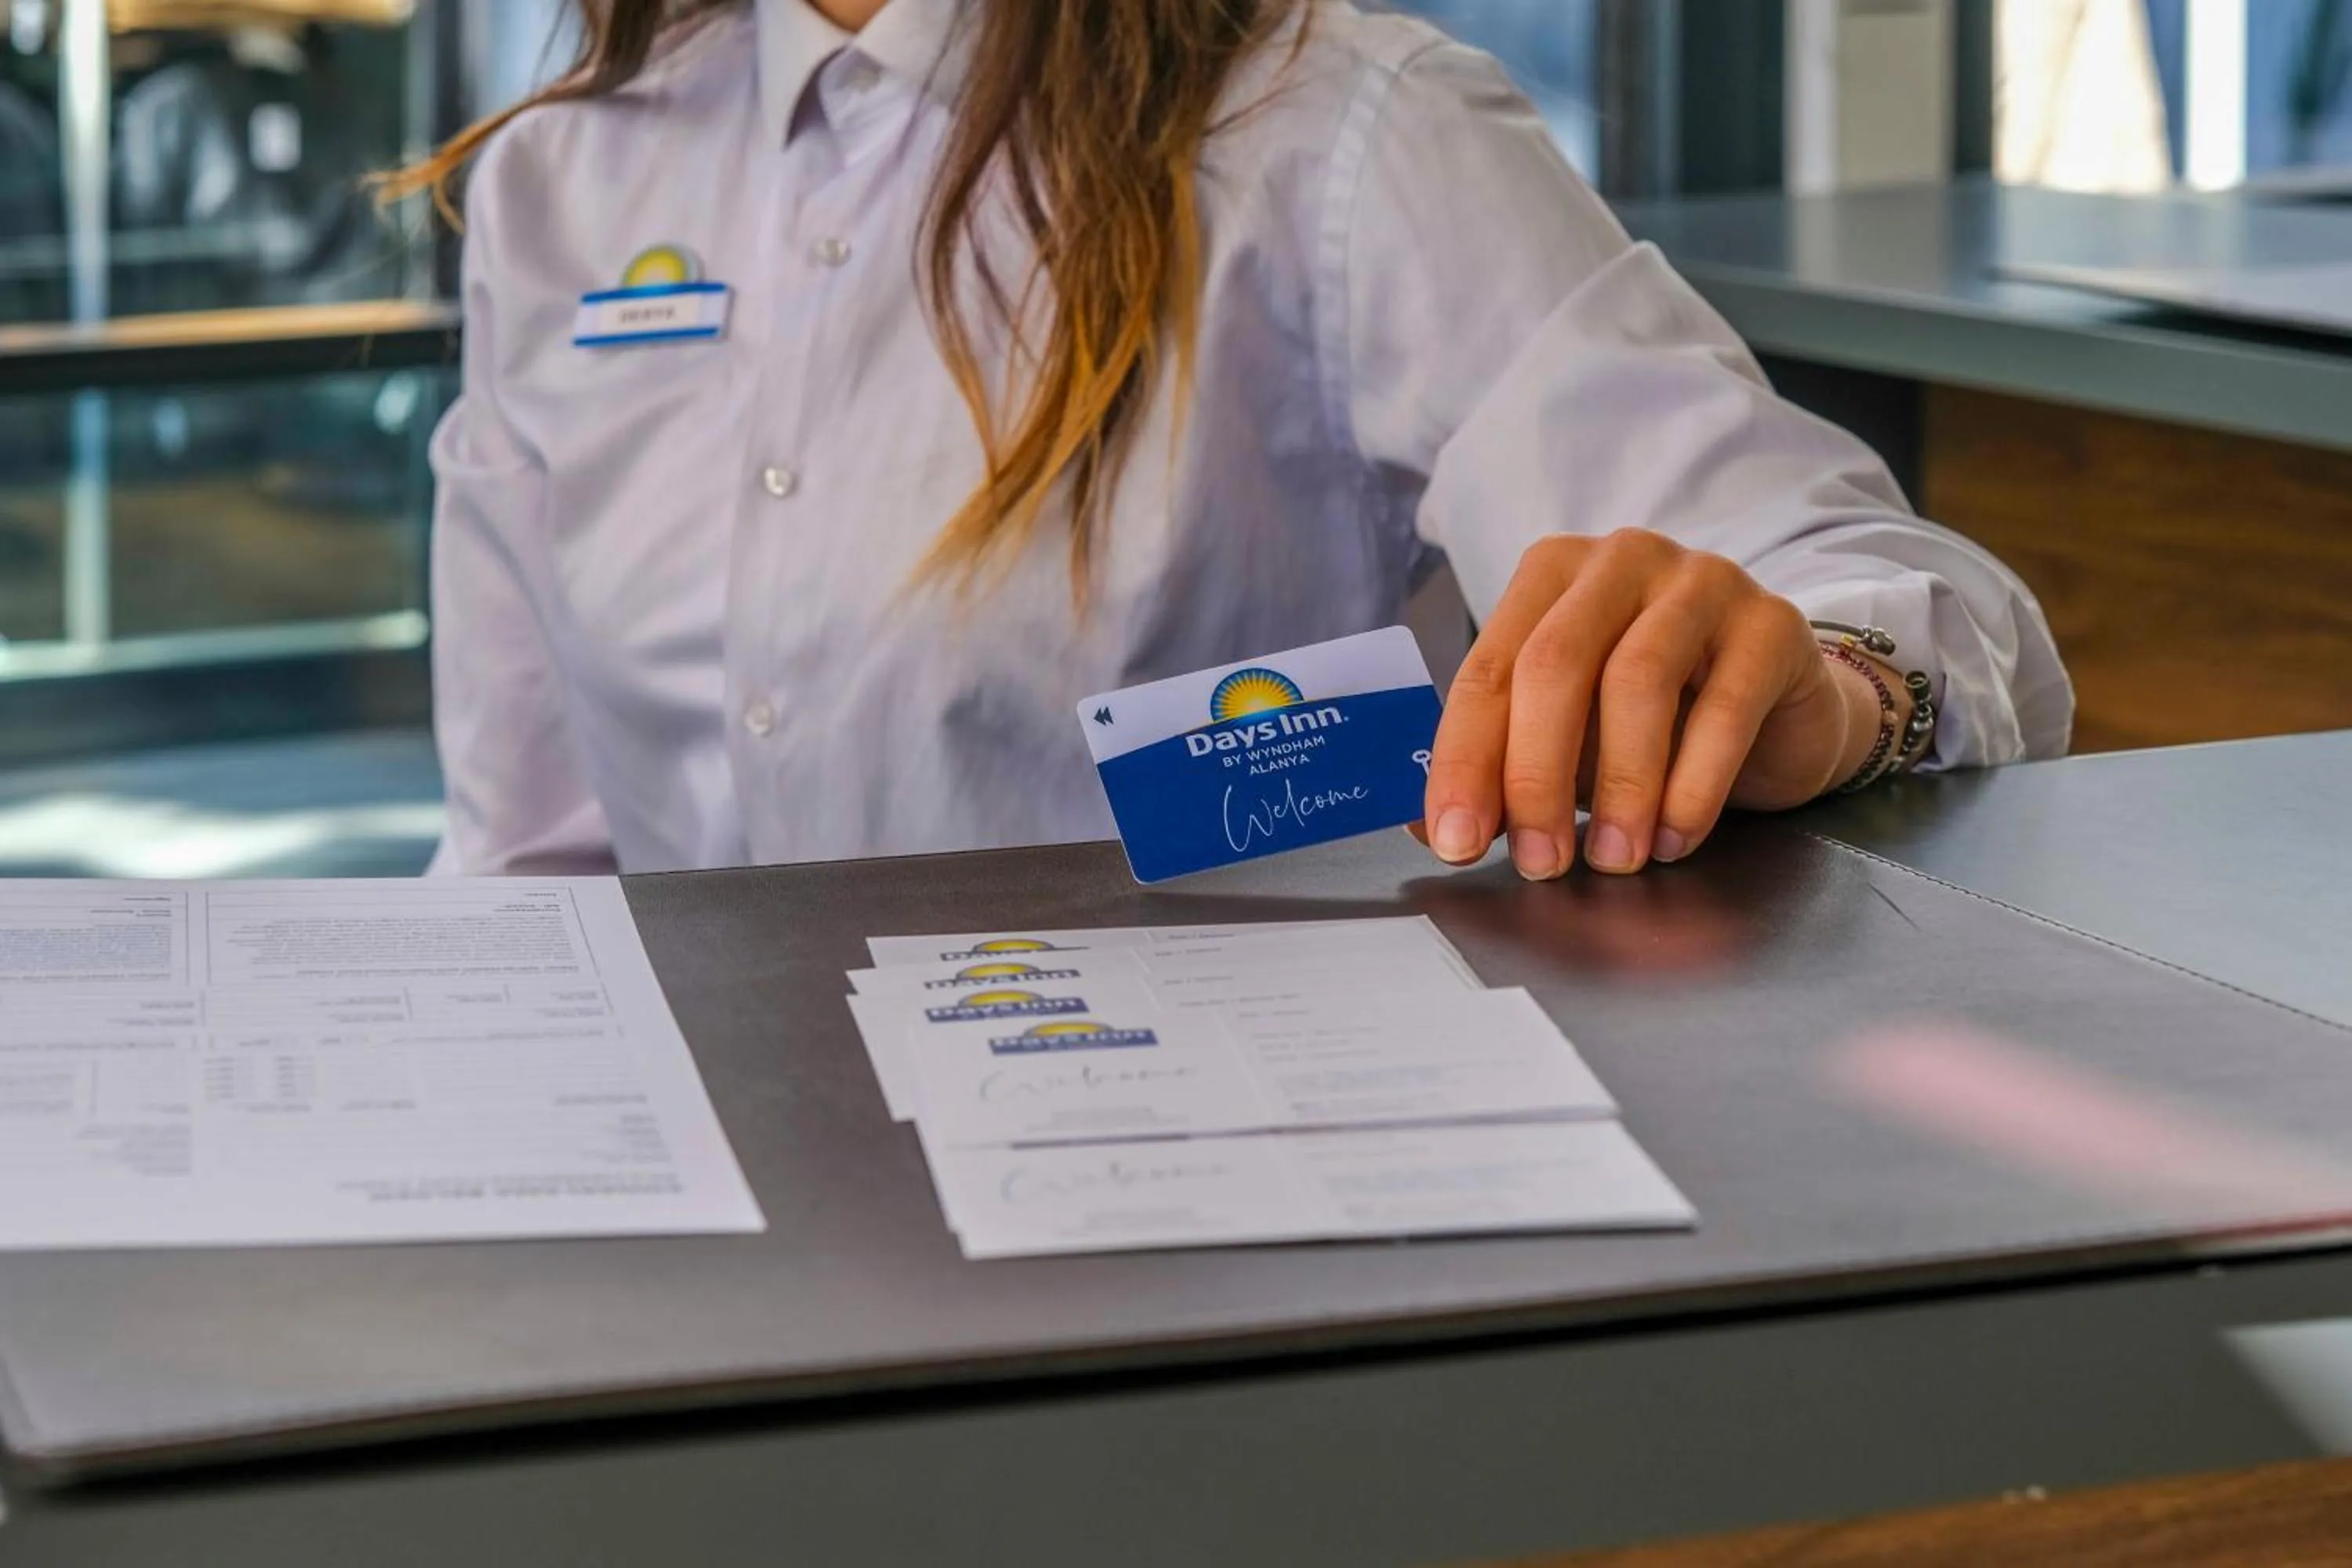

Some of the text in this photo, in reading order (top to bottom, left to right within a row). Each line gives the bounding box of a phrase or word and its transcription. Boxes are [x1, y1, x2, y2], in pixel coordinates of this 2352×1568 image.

[1185, 721, 1276, 757] Days
[1223, 735, 1326, 768] BY WYNDHAM
[1250, 753, 1310, 775] ALANYA
[1224, 778, 1369, 852] Welcome
